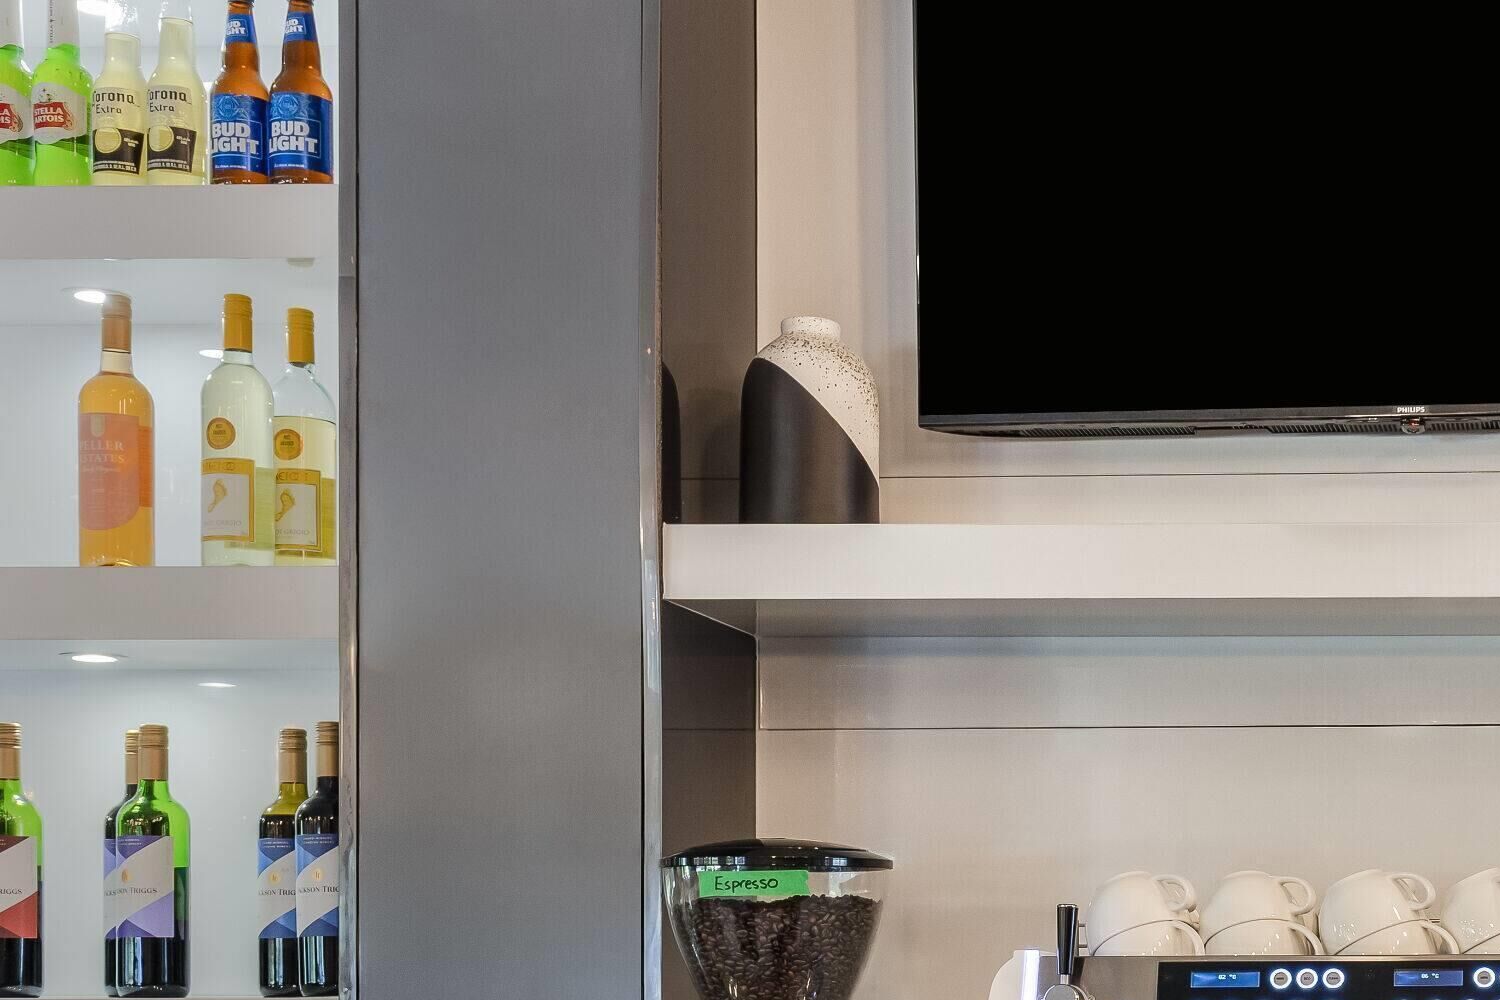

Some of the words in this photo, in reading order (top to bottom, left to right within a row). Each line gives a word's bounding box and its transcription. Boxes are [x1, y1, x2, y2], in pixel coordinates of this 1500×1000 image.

[148, 89, 187, 102] orona
[34, 106, 64, 116] STELLA
[96, 104, 122, 114] Extra
[149, 102, 175, 112] Extra
[212, 121, 251, 138] BUD
[271, 120, 310, 137] BUD
[715, 875, 779, 893] Espresso
